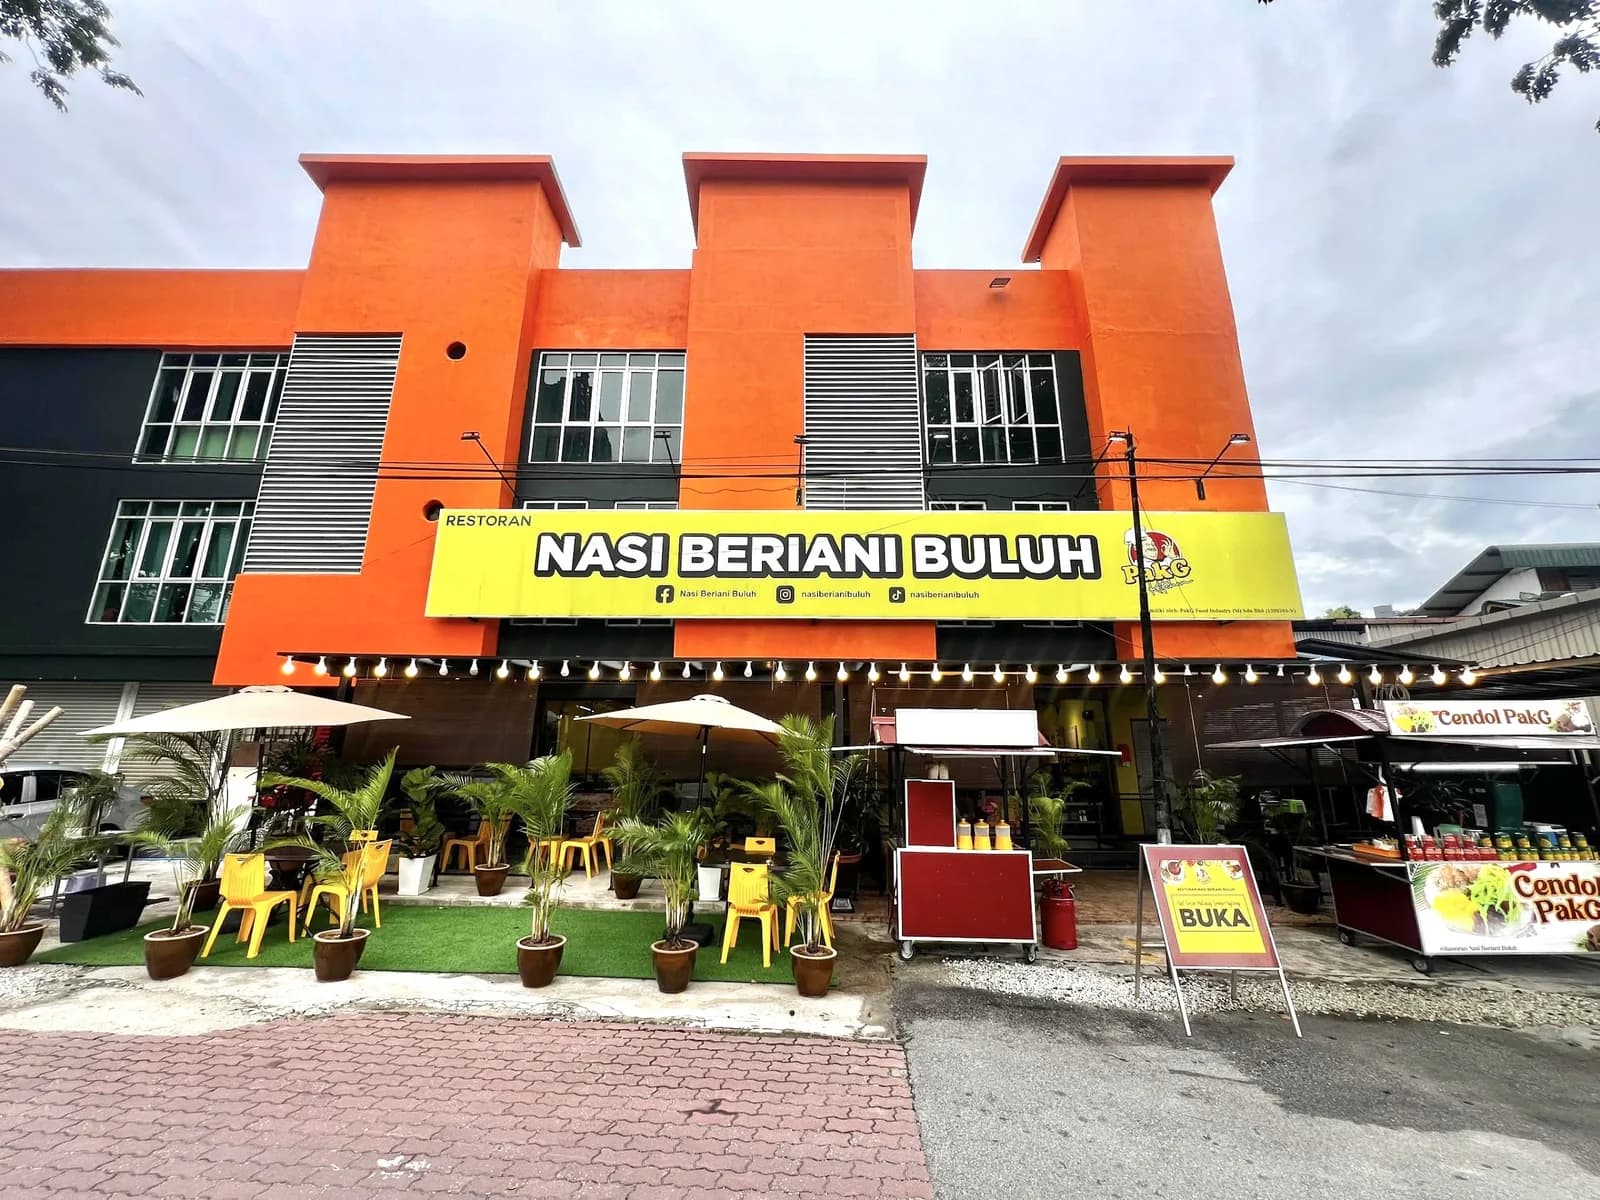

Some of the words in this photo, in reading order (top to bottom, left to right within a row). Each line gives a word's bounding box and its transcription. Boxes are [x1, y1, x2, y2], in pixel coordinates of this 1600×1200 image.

[446, 515, 532, 526] RESTORAN
[534, 533, 668, 578] NASI
[679, 533, 903, 578] BERIANI
[912, 533, 1102, 579] BULUH
[1121, 558, 1191, 584] PakG
[801, 590, 871, 598] nasiberianibuluh
[910, 591, 980, 599] nasiberianibuluh
[1439, 709, 1501, 725] Cendol
[1505, 709, 1551, 725] PakG
[1179, 908, 1250, 927] BUKA
[1534, 898, 1600, 923] PakG
